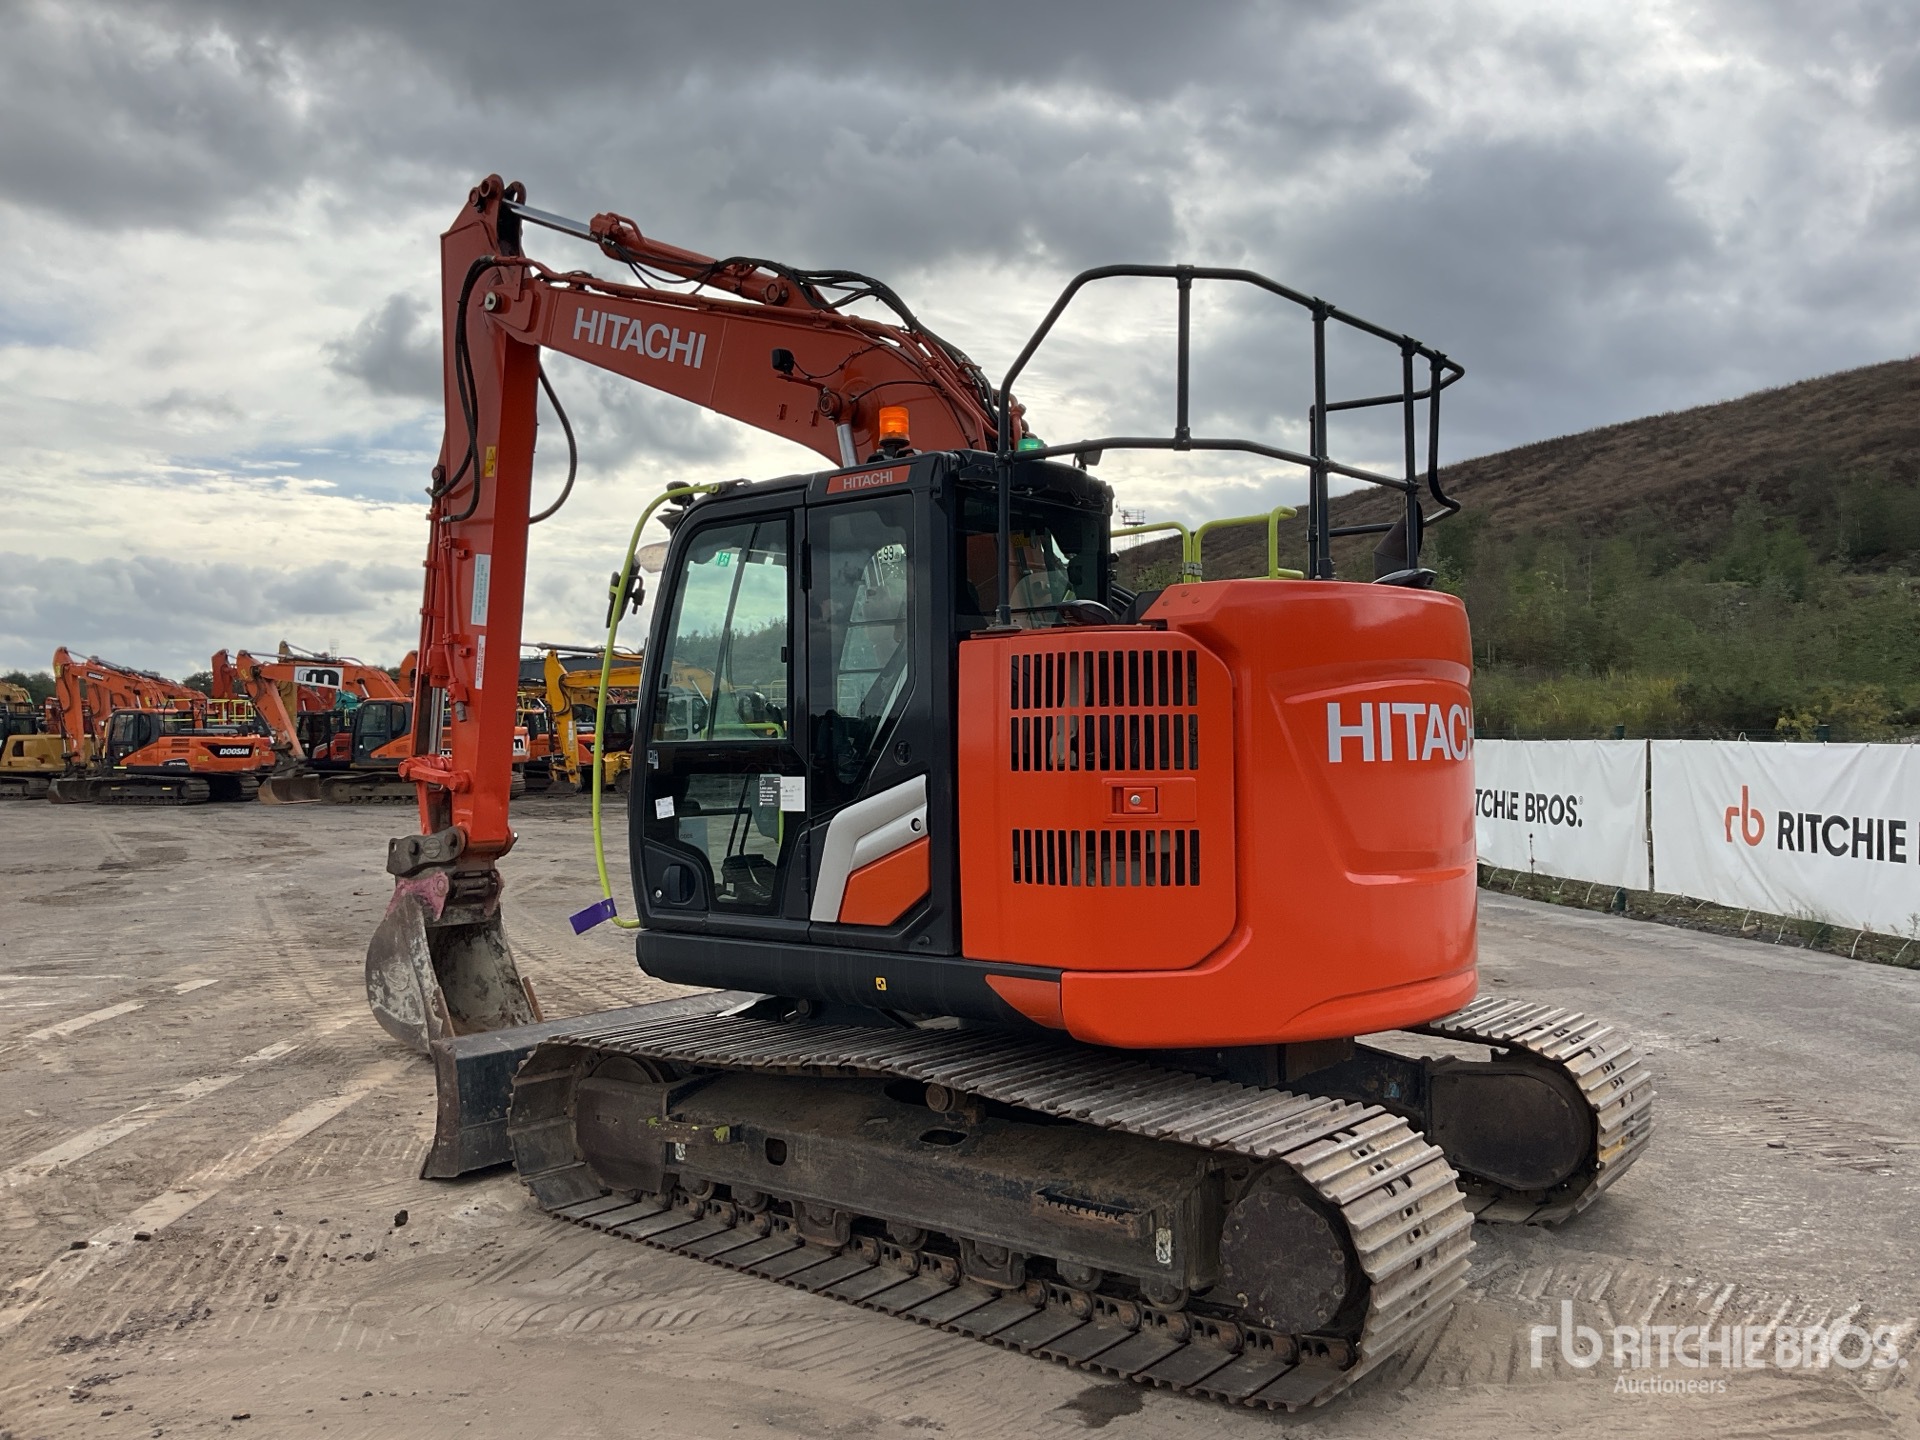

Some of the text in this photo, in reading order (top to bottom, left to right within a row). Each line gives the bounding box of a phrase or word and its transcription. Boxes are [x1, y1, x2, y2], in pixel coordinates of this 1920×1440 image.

[573, 307, 706, 369] HITACHI
[843, 470, 893, 490] HITACHI
[883, 546, 893, 560] 99
[1475, 788, 1519, 821] TCHIE
[1777, 810, 1907, 864] RITCHIE
